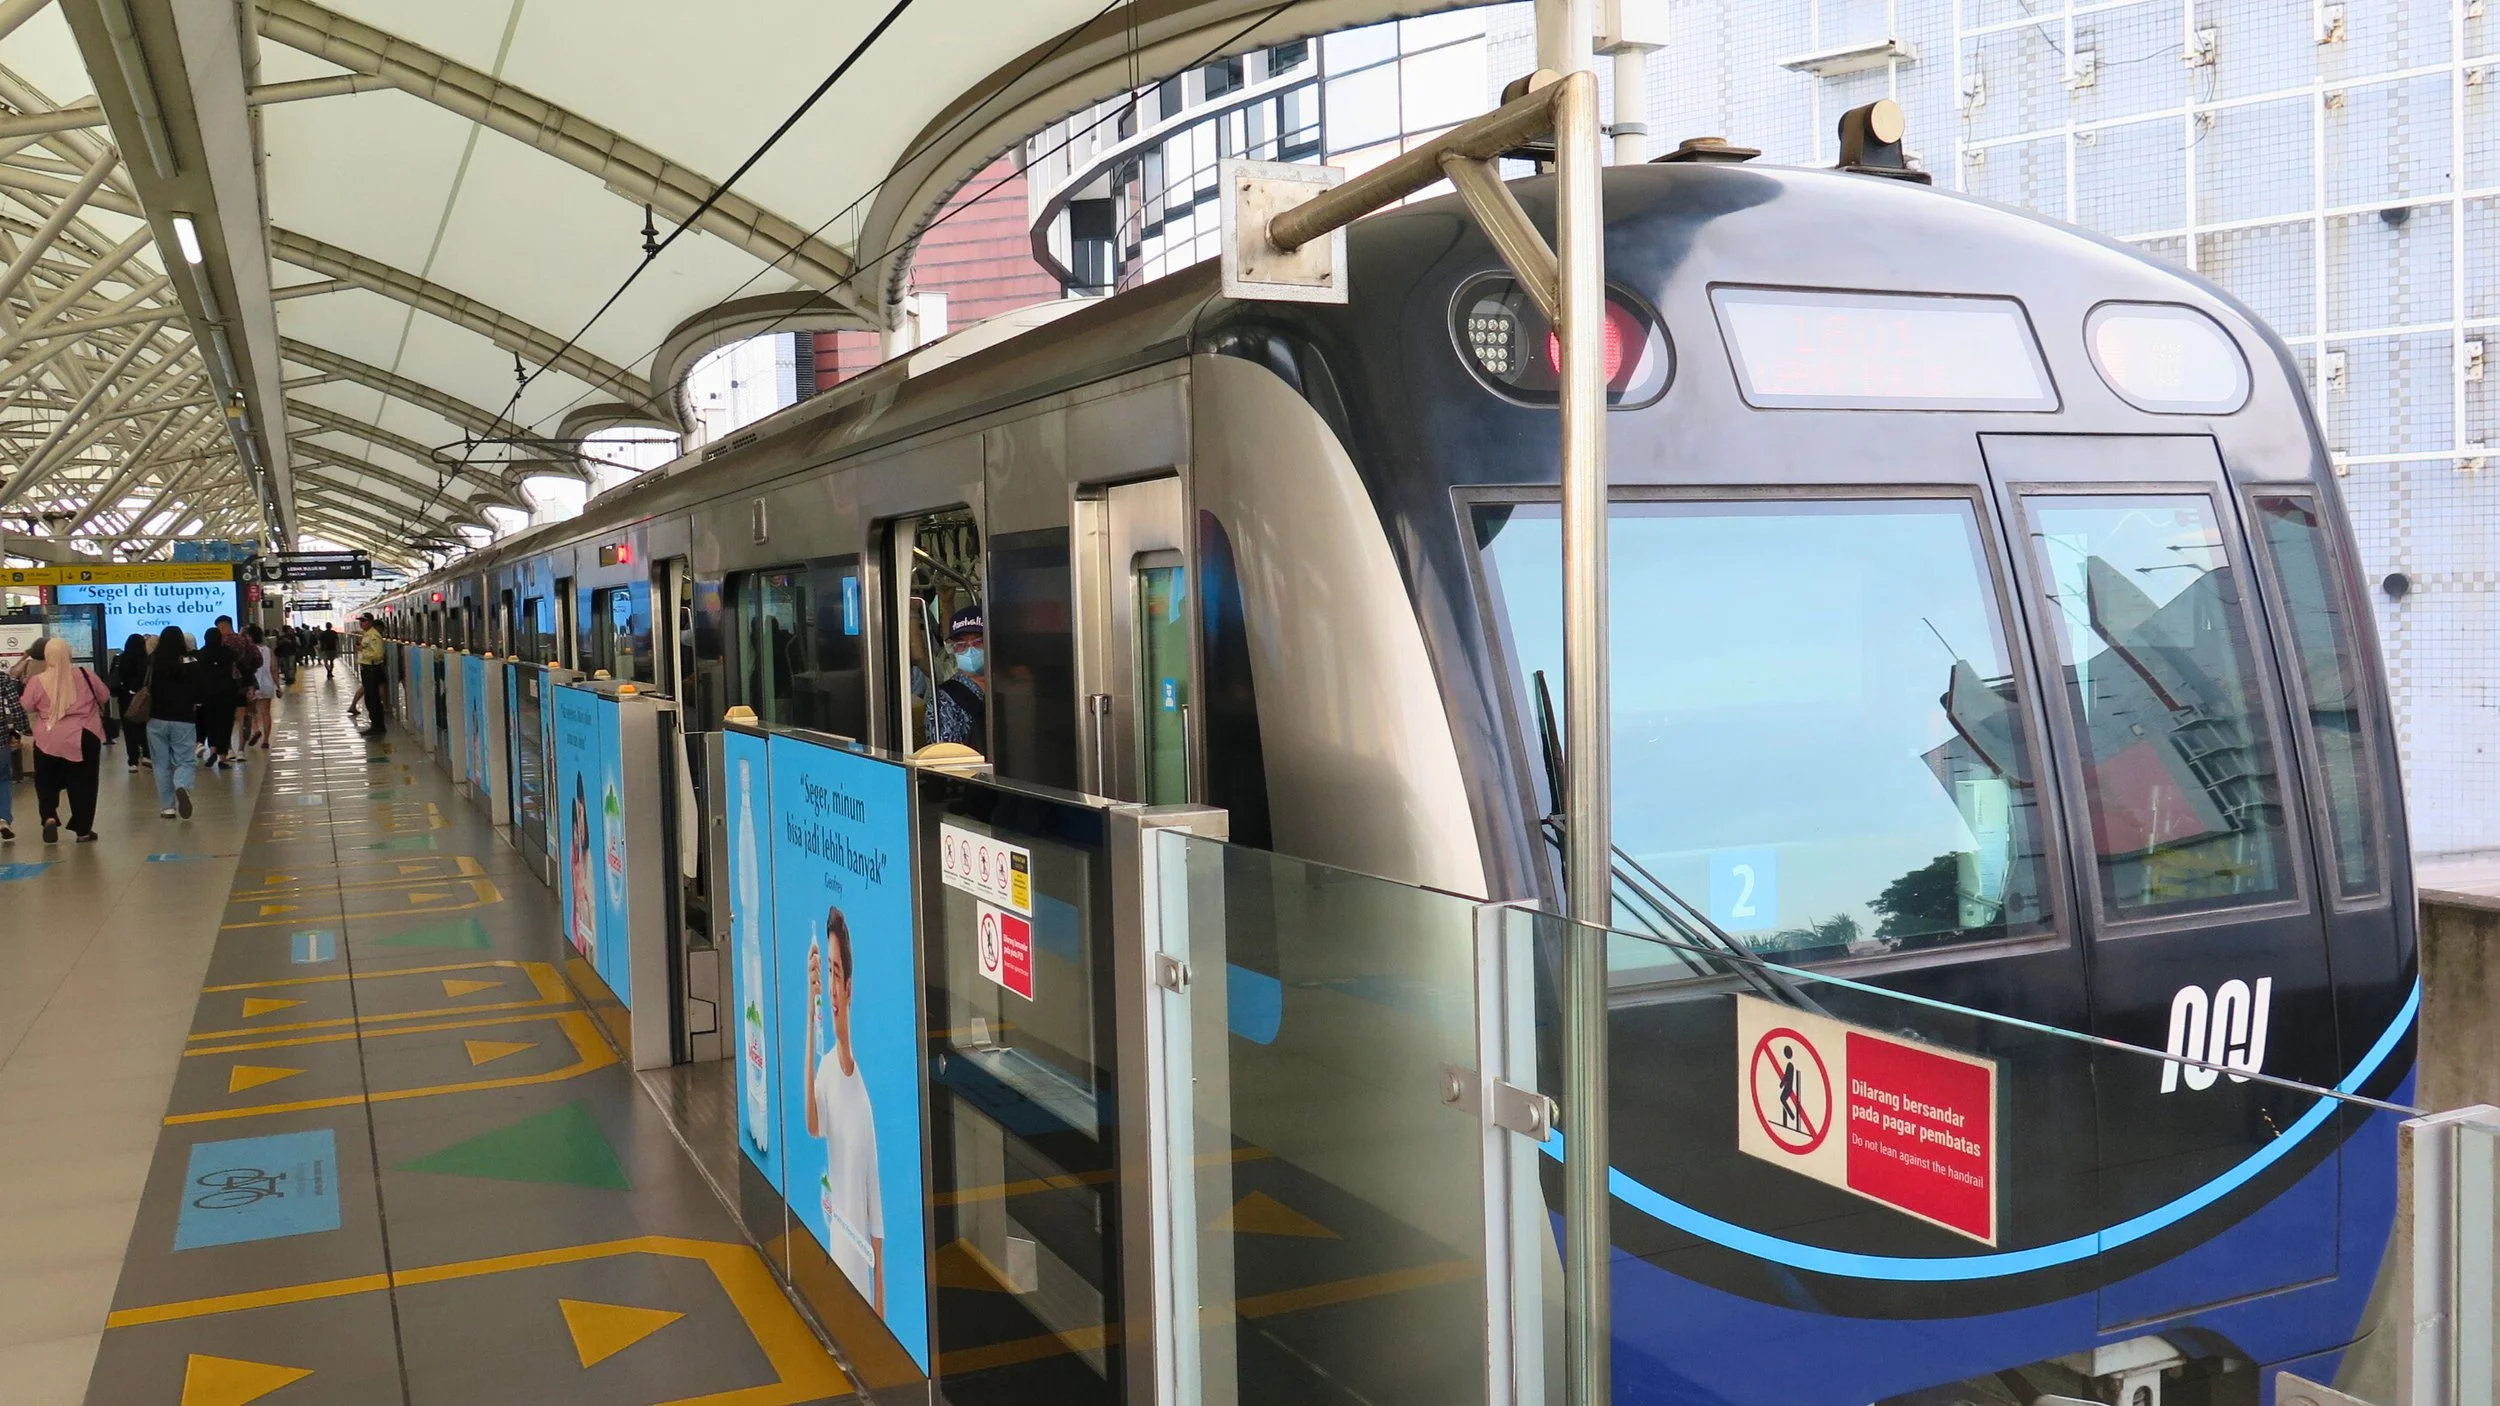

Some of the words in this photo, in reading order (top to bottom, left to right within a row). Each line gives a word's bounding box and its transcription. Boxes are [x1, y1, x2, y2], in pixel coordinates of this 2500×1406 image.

[128, 601, 172, 614] bebas
[134, 585, 148, 597] di
[154, 585, 225, 600] tutupnya,
[847, 587, 854, 627] 1
[832, 783, 865, 824] minum
[786, 811, 802, 848] bisa
[803, 819, 820, 859] jadi
[821, 826, 845, 868] lebih
[1731, 863, 1756, 918] 2
[1851, 1078, 1900, 1111] Dilarang
[1903, 1094, 1966, 1128] bersandar
[1852, 1104, 1880, 1124] pada
[1883, 1114, 1917, 1136] pagar
[1919, 1125, 1982, 1158] pembatas
[1852, 1133, 1863, 1147] Do
[1864, 1139, 1878, 1151] not
[1880, 1142, 1898, 1159] lean
[1899, 1151, 1930, 1170] against
[1932, 1161, 1947, 1176] the
[1947, 1165, 1985, 1189] handrail
